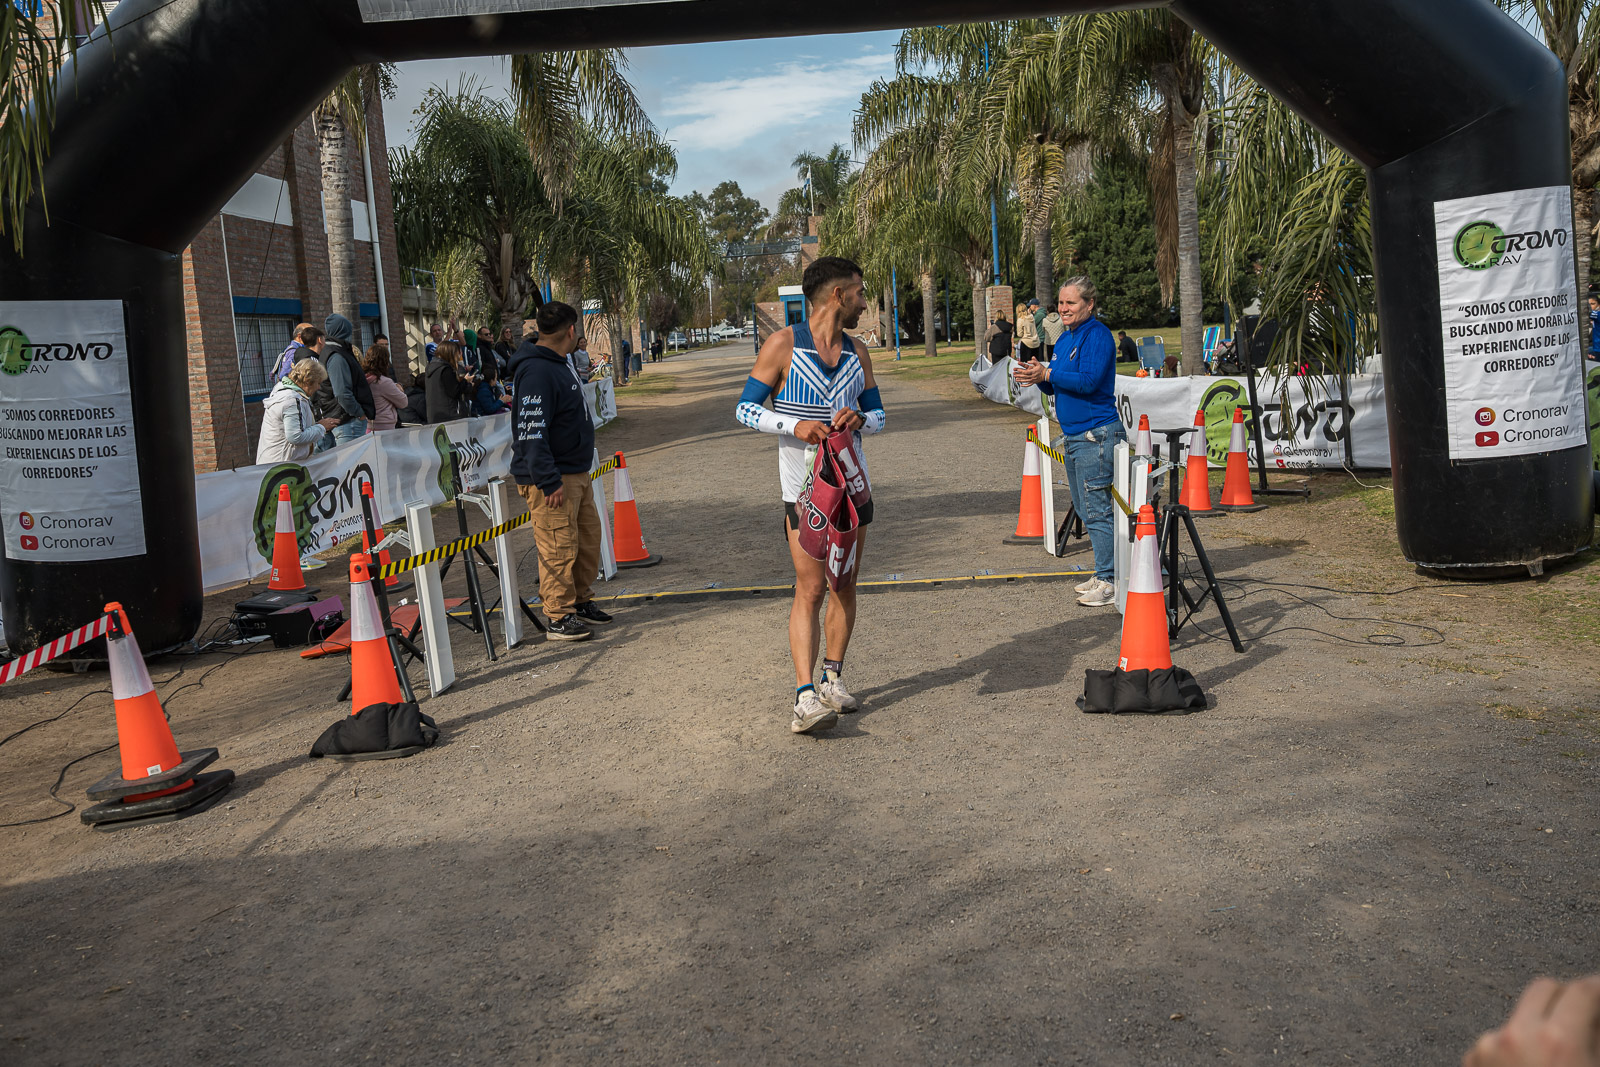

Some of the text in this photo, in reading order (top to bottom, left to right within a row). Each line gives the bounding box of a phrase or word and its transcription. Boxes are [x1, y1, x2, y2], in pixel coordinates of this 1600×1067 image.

[1491, 228, 1567, 254] CRONO
[1490, 254, 1522, 267] RAV
[1508, 294, 1568, 313] CORREDORES
[1450, 312, 1575, 338] BUSCANDO MEJORAR LAS
[20, 342, 113, 362] CRONO
[1462, 332, 1570, 356] EXPERIENCIAS DE LOS
[20, 364, 49, 374] RAV
[38, 407, 115, 421] CORREDORES
[1503, 405, 1569, 423] Cronorav
[0, 425, 127, 441] BUSCANDO MEJORAR LAS
[1503, 425, 1570, 443] Cronorav
[6, 445, 118, 460] EXPERIENCIAS DE LOS
[40, 515, 114, 530] Cronorav
[42, 535, 116, 550] Cronorav
